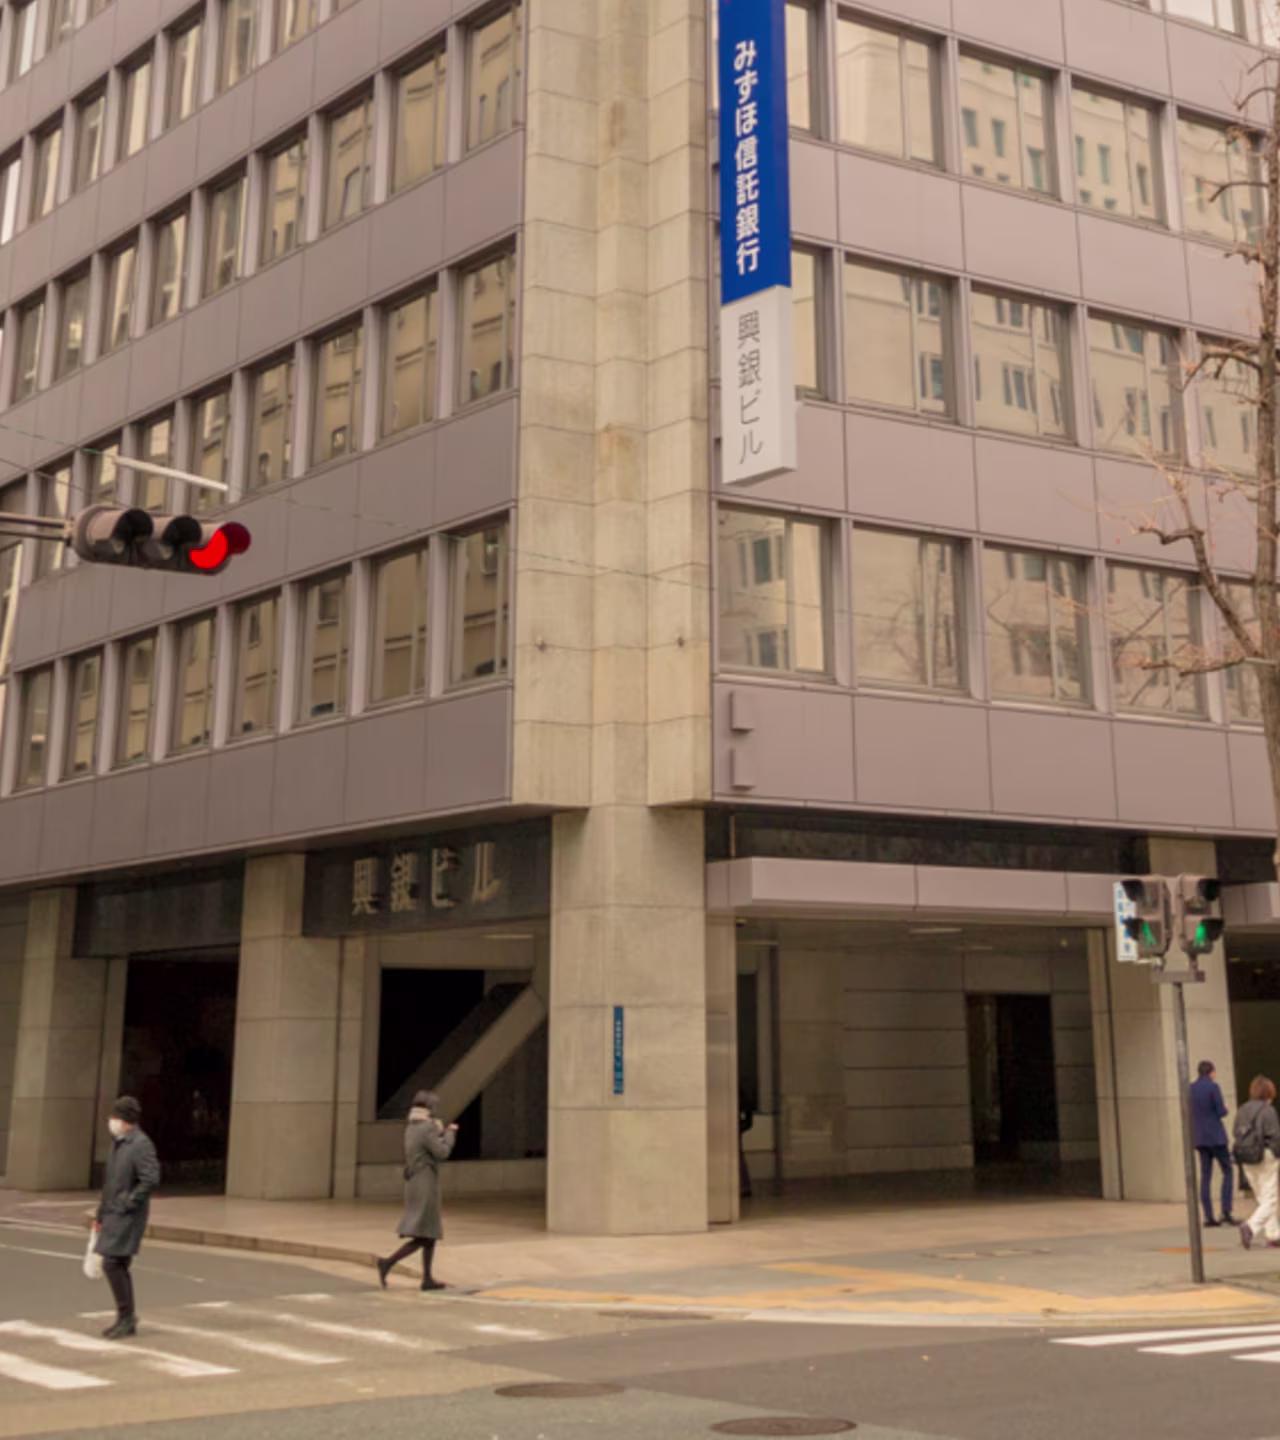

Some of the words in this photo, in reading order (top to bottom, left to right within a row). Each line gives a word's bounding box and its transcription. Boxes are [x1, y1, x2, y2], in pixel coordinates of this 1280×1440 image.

[733, 39, 760, 276] みずほ信託銀行
[736, 309, 764, 465] 興銀ビル
